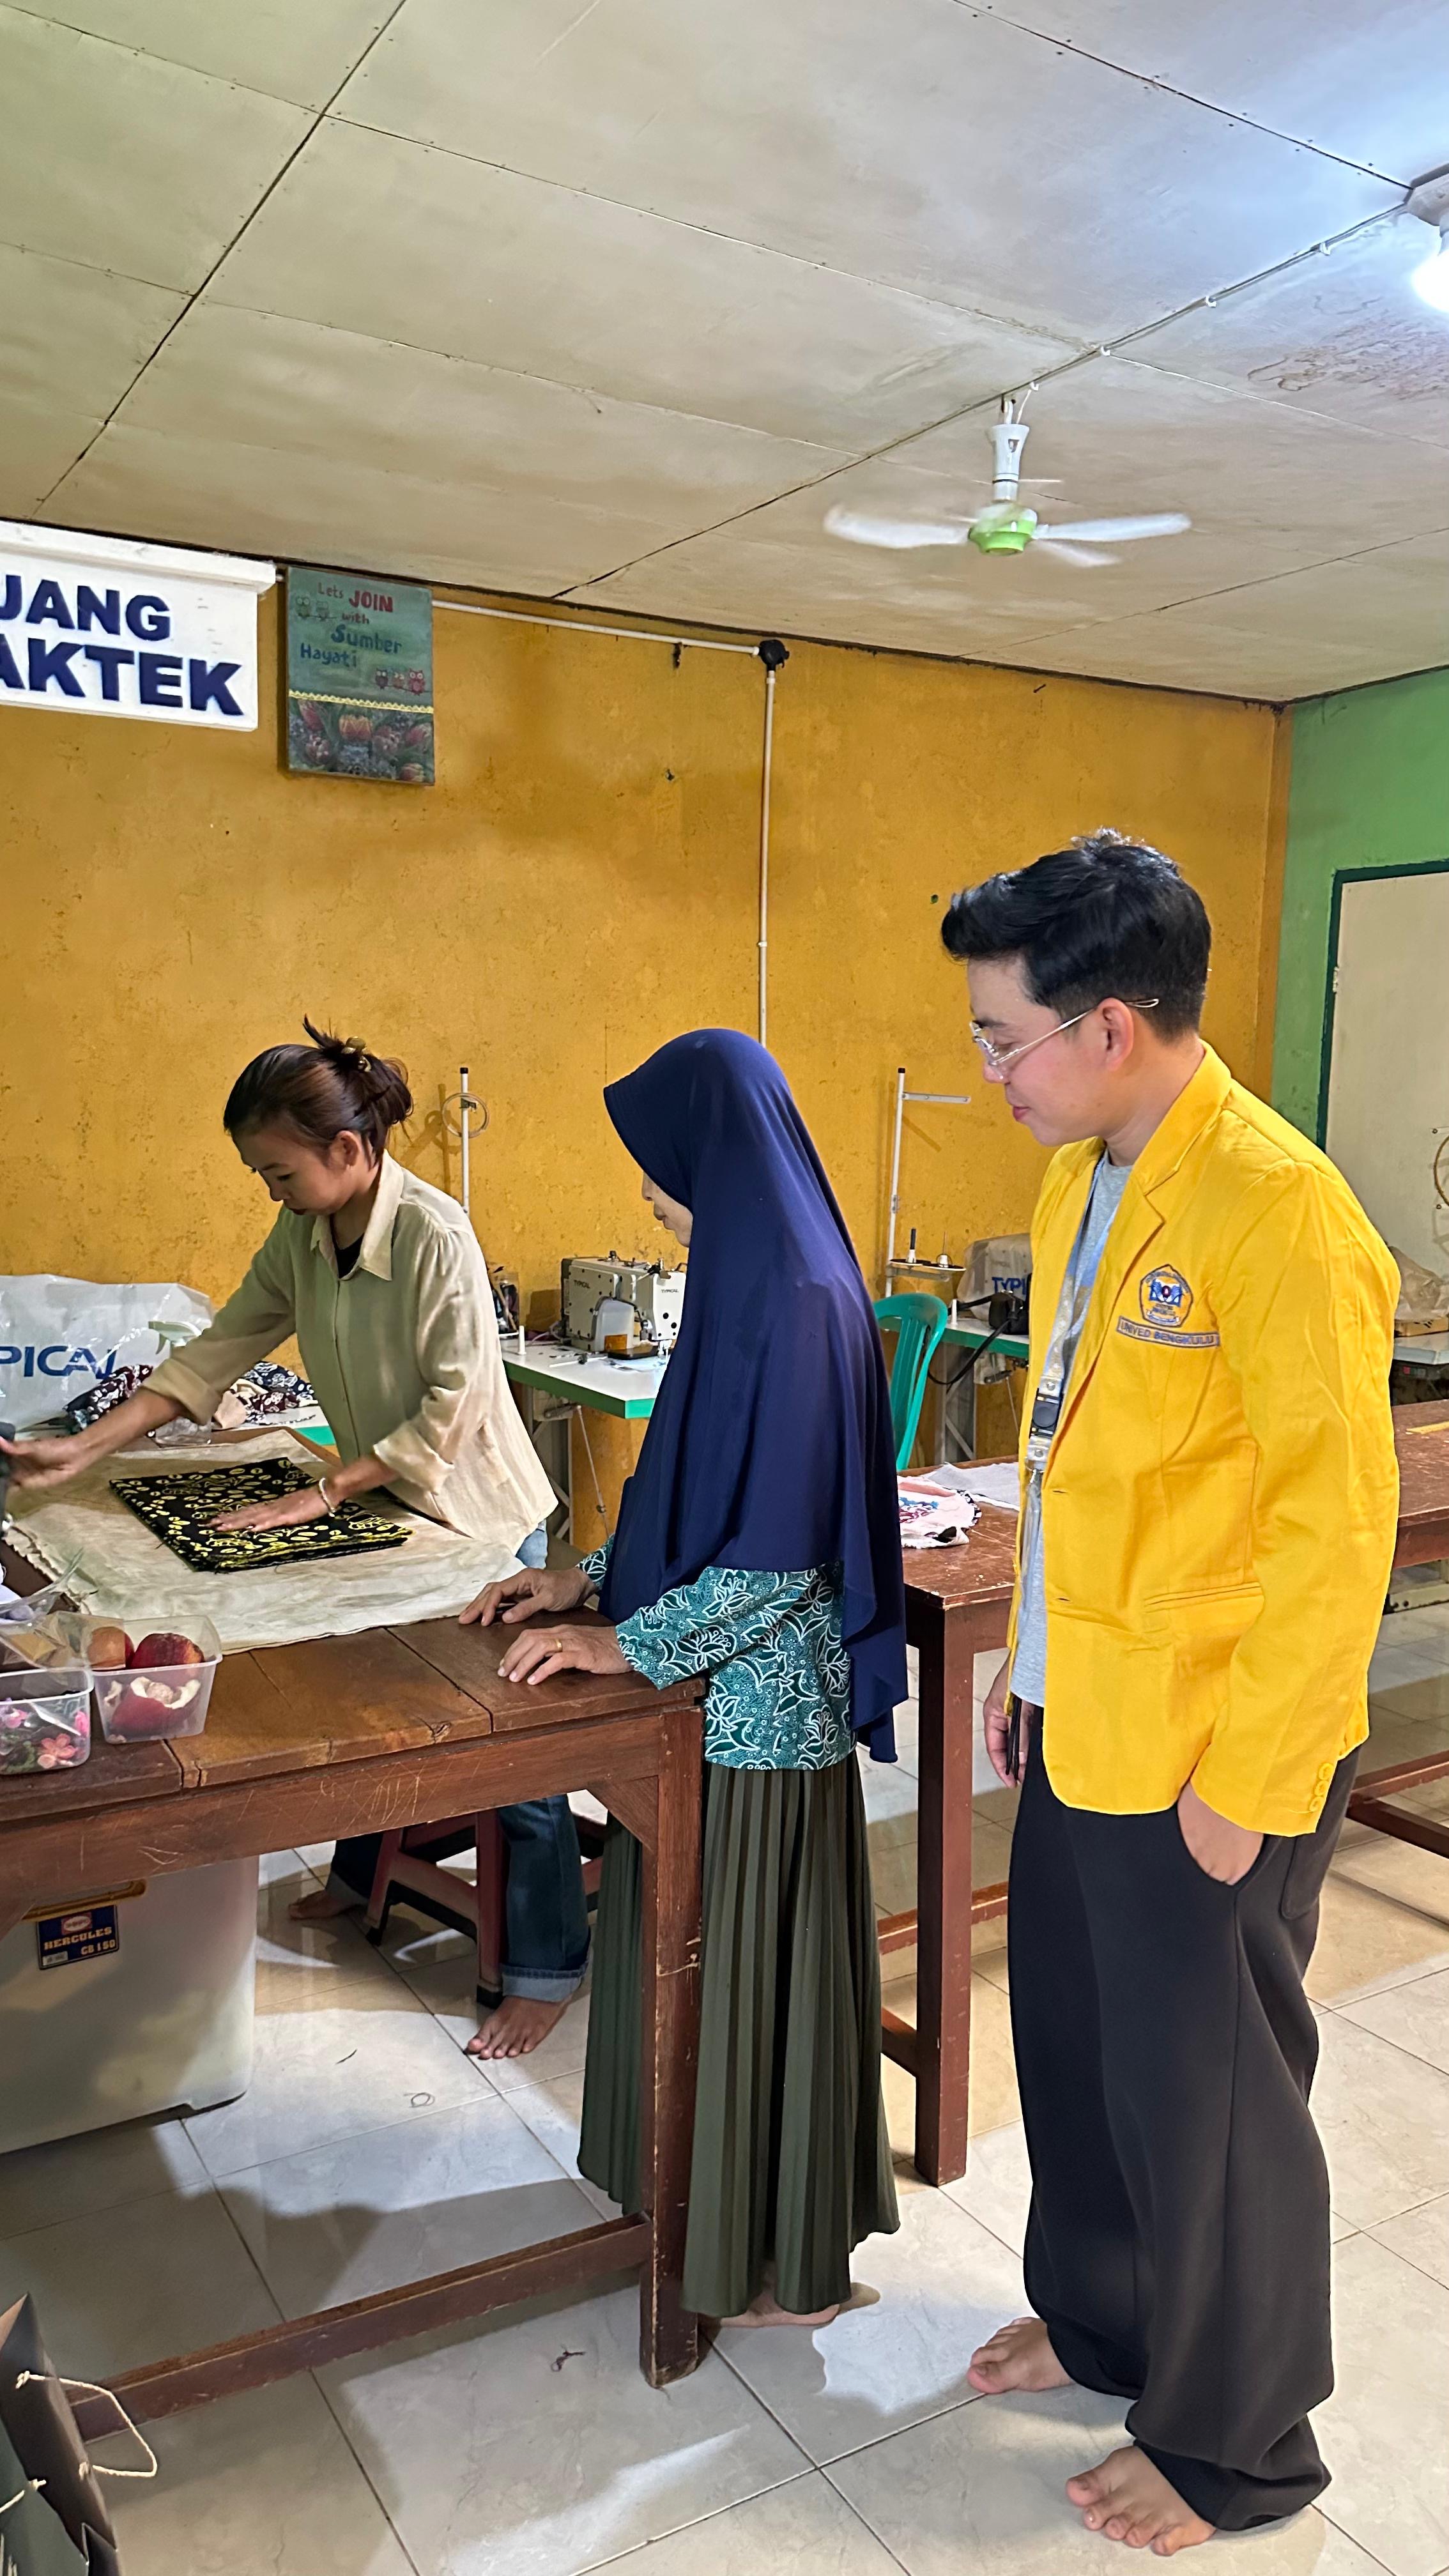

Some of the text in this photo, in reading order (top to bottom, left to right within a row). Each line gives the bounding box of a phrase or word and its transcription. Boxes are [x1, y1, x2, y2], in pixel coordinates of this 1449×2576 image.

[318, 582, 394, 613] Lets JOIN
[342, 612, 370, 624] with
[331, 624, 402, 654] Sumber
[300, 642, 357, 668] Hayati
[44, 1926, 112, 1950] HERCULES
[80, 1939, 116, 1955] CB 150
